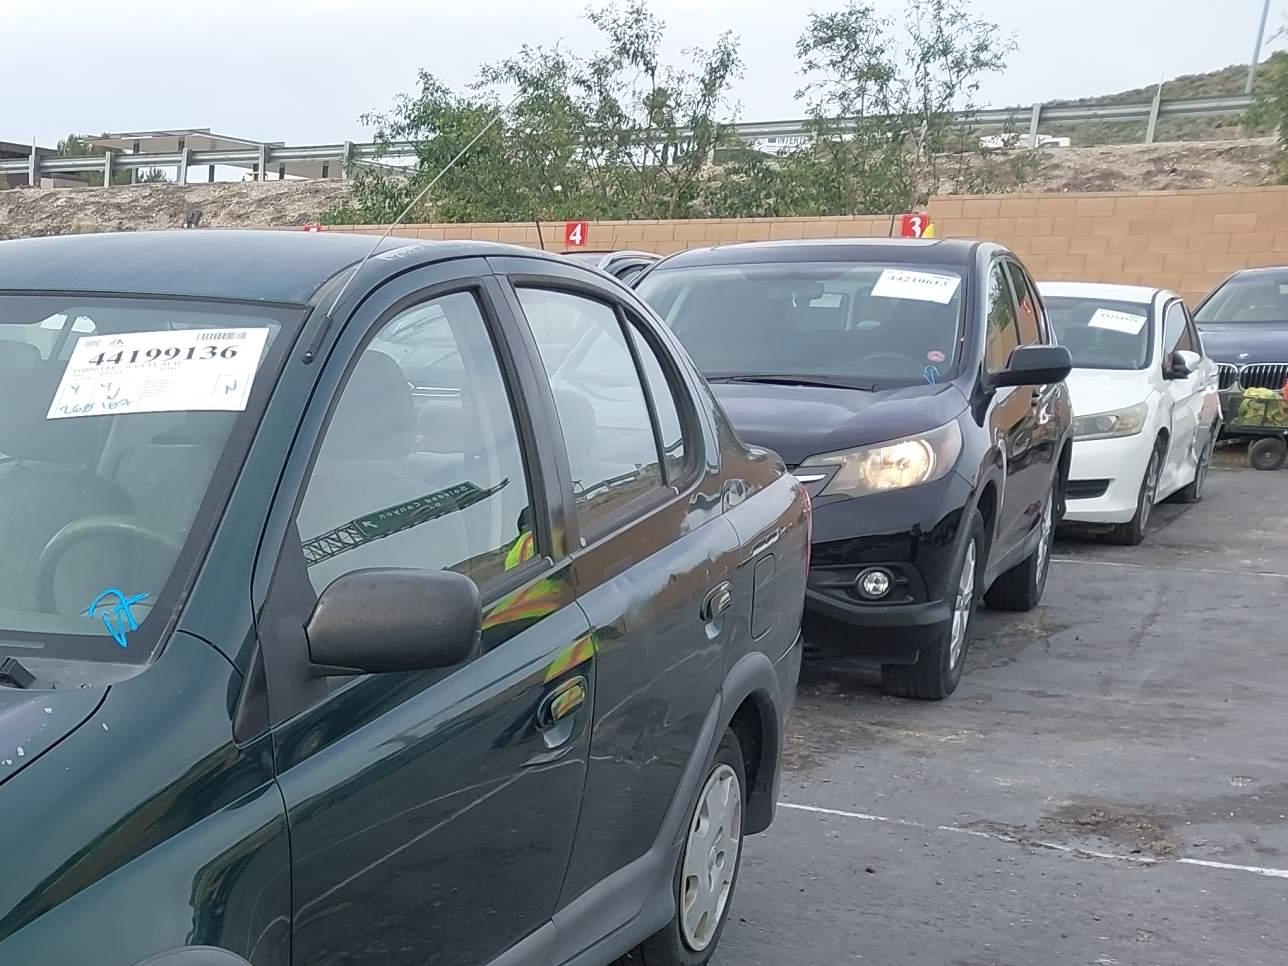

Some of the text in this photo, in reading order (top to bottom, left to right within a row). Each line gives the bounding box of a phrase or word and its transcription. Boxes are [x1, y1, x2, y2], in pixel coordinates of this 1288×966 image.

[569, 223, 582, 245] 4
[908, 216, 922, 238] 3
[88, 345, 239, 366] 44199136
